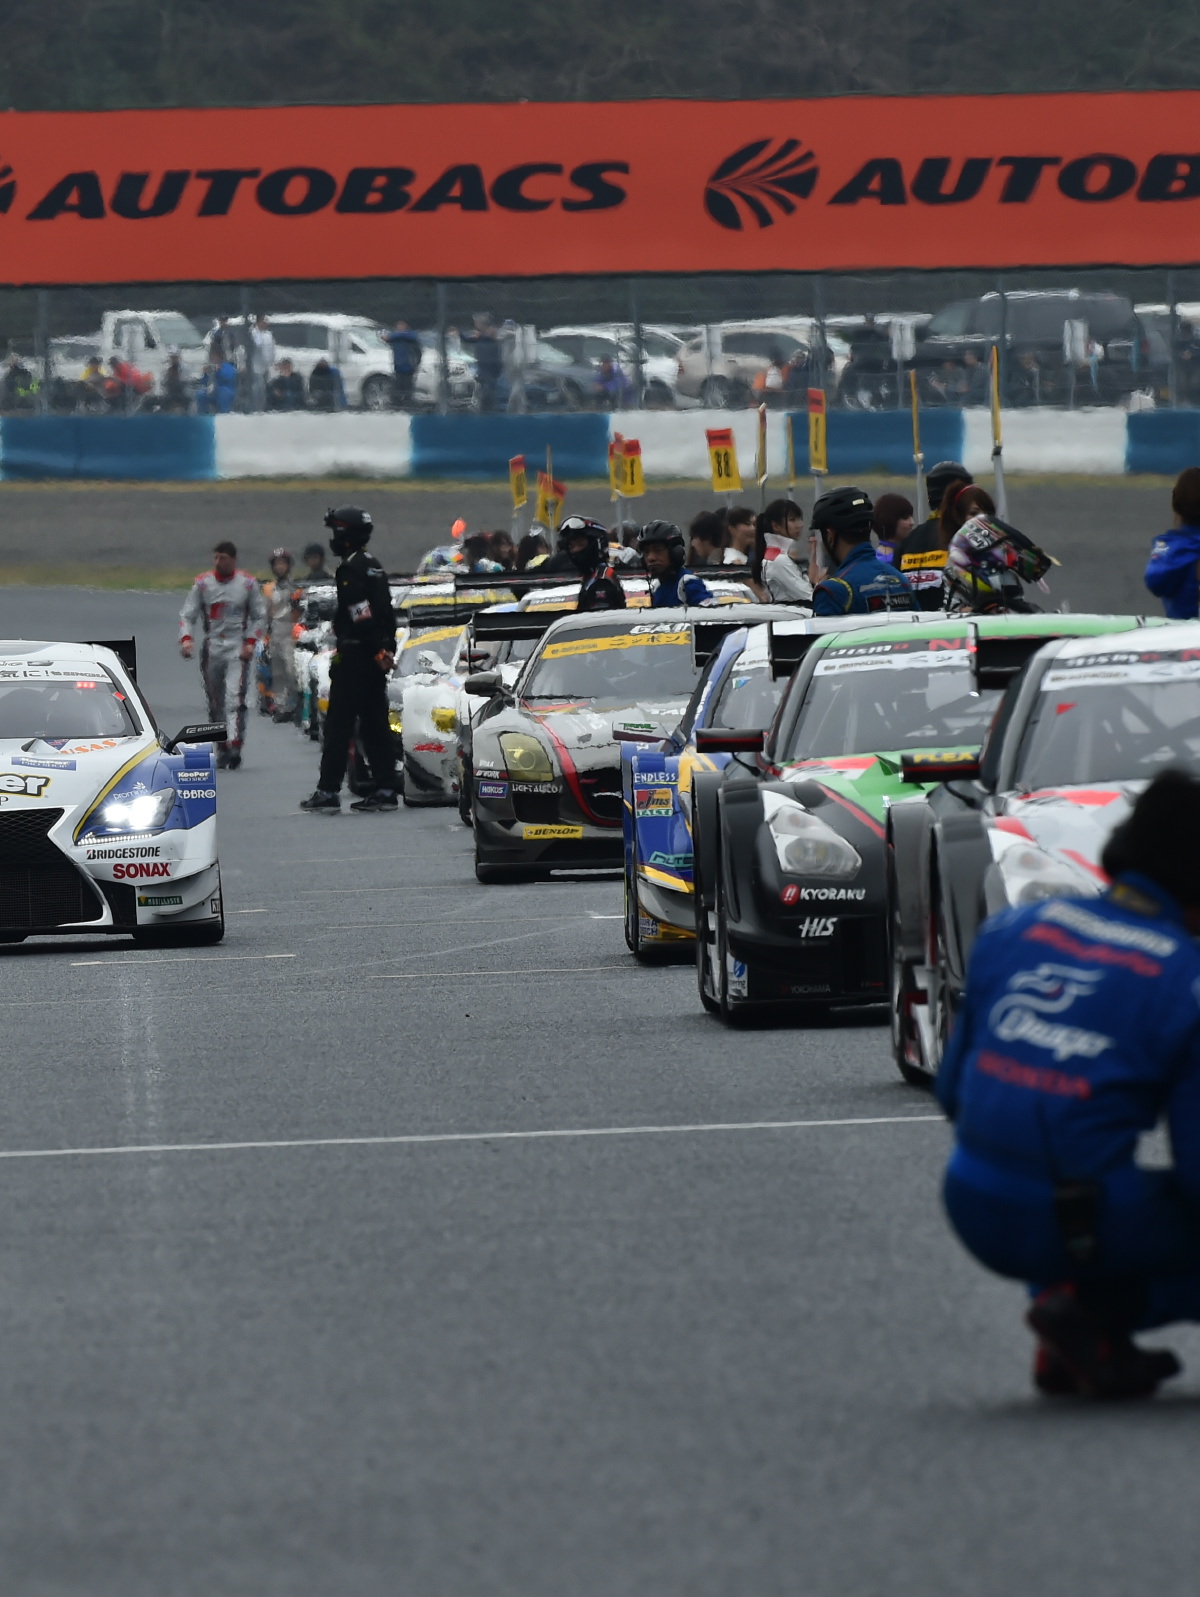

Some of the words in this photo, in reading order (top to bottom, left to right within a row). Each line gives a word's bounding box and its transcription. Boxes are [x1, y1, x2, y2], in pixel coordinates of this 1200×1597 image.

[25, 162, 630, 221] AUTOBACS
[634, 772, 676, 783] ENDLESS
[533, 828, 580, 836] DUNLOP
[86, 846, 160, 860] BRIDGESTONE
[112, 863, 171, 879] SONAX
[800, 887, 866, 901] KYORAKU
